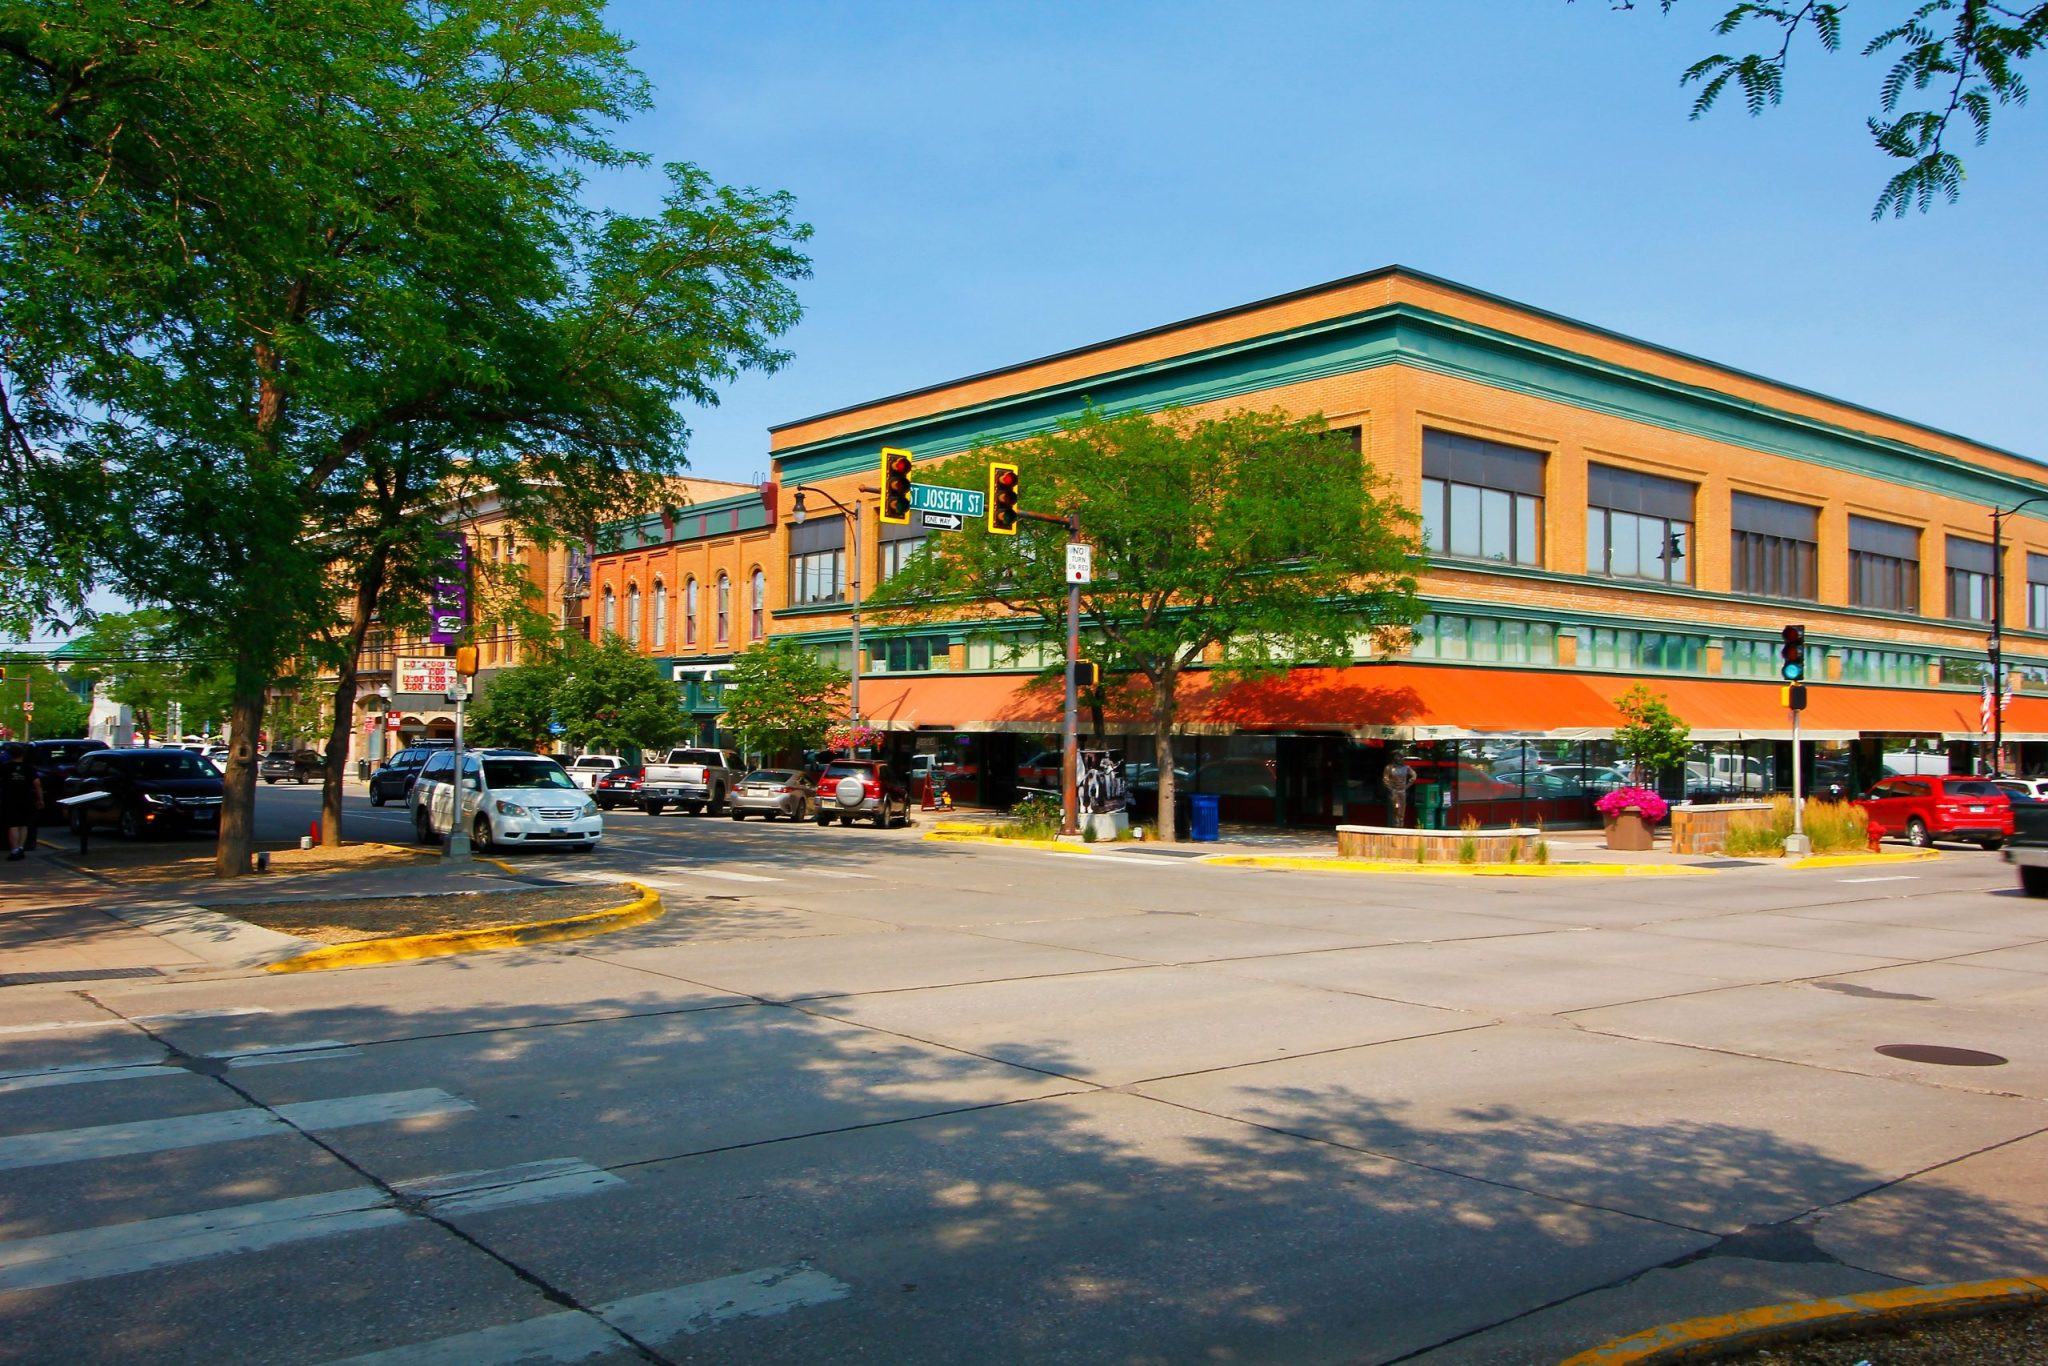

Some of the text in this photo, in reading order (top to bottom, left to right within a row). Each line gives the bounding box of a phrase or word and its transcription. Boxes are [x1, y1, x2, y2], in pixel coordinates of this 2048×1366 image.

[923, 488, 963, 511] JOSEPH
[968, 494, 980, 513] ST
[1073, 547, 1084, 555] NO
[1072, 555, 1086, 563] TURN
[403, 675, 425, 683] 12:00
[427, 683, 446, 691] 4:00
